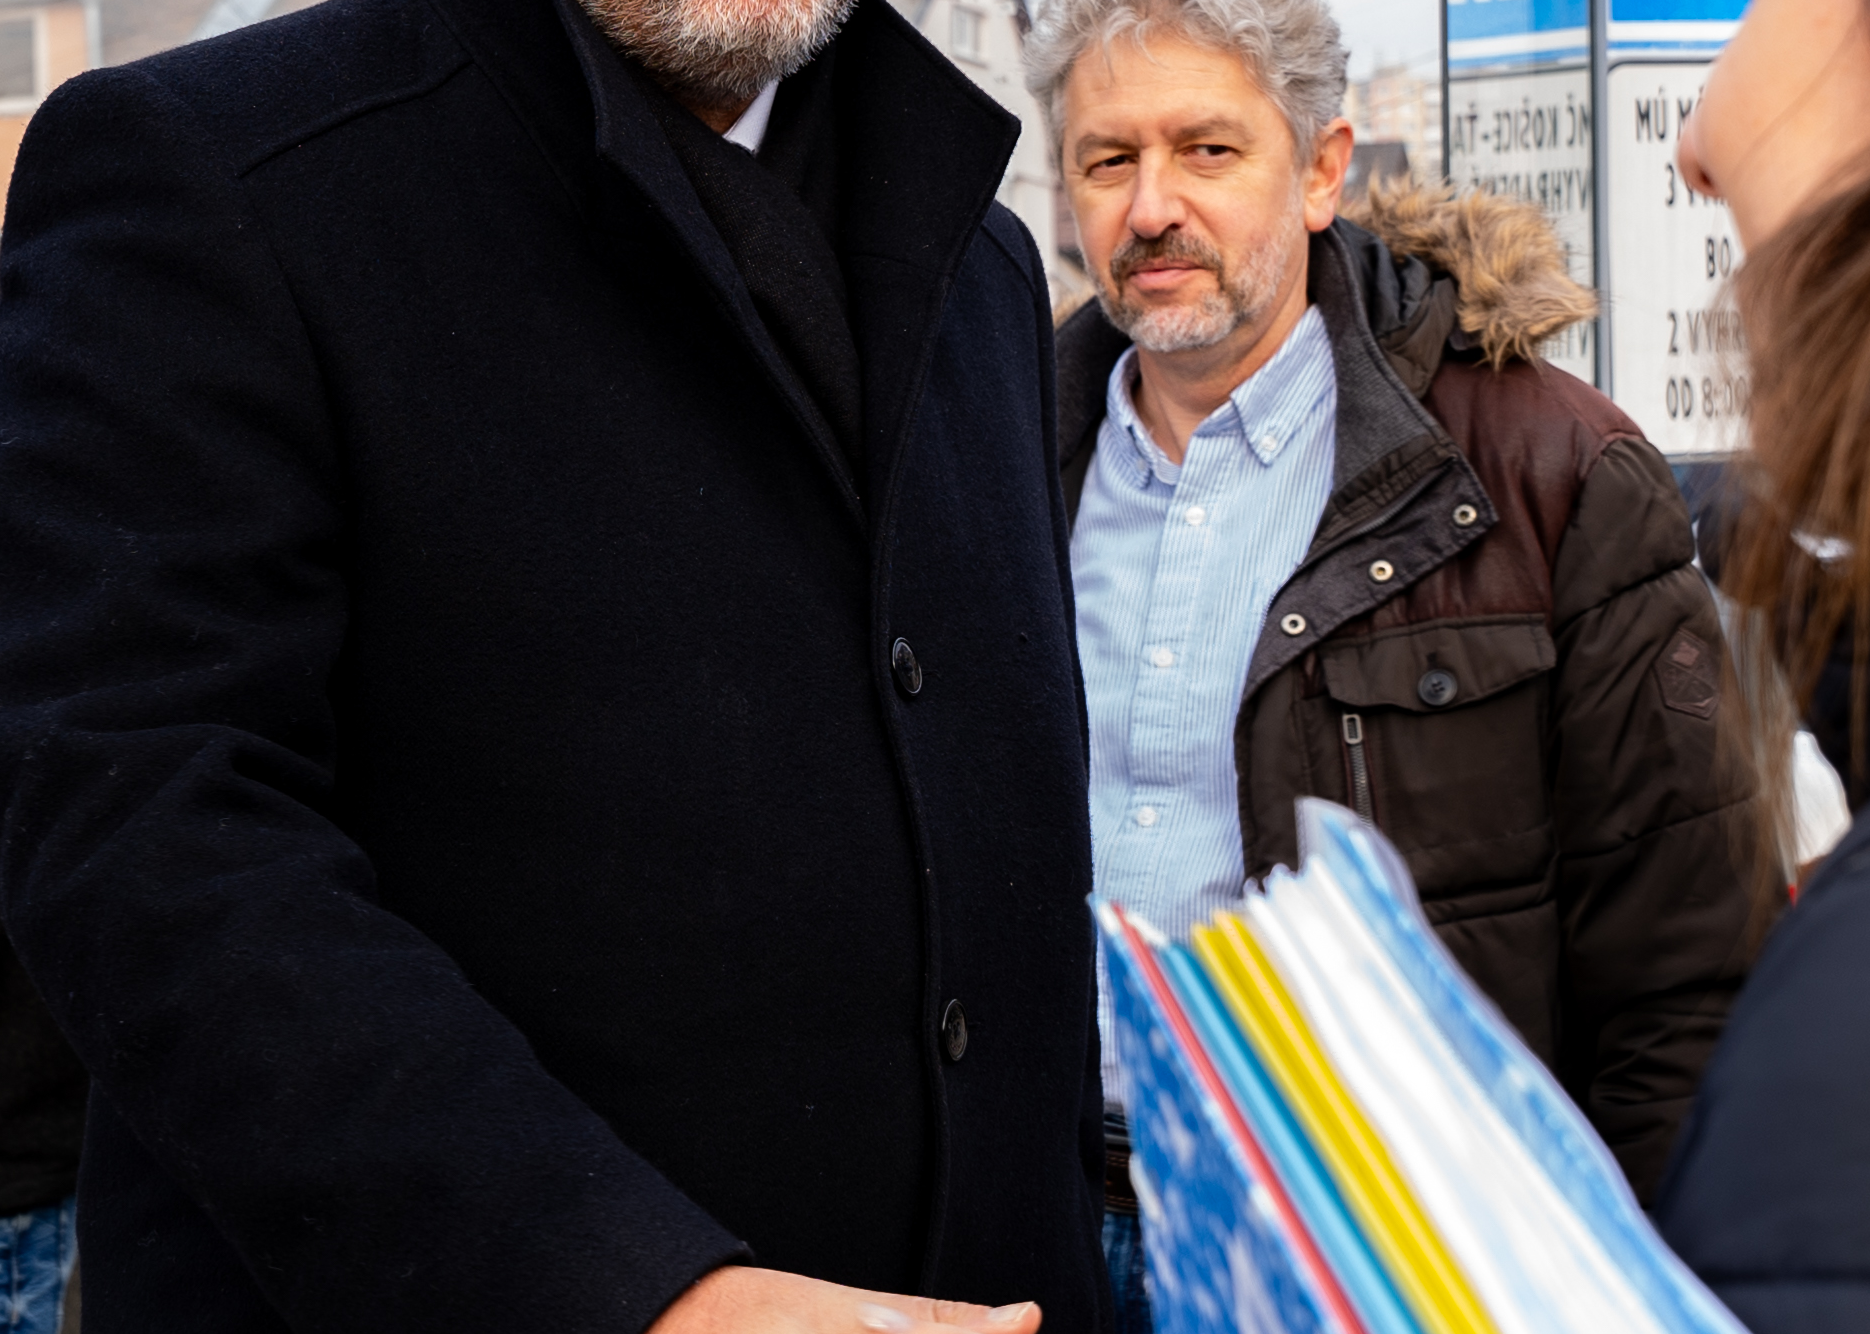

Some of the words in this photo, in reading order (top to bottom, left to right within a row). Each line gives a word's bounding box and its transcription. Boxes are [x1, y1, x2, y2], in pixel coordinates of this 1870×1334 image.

[1635, 85, 1666, 142] MÚ
[1665, 162, 1675, 207] 3
[1666, 310, 1679, 354] 2
[1666, 377, 1693, 420] OD
